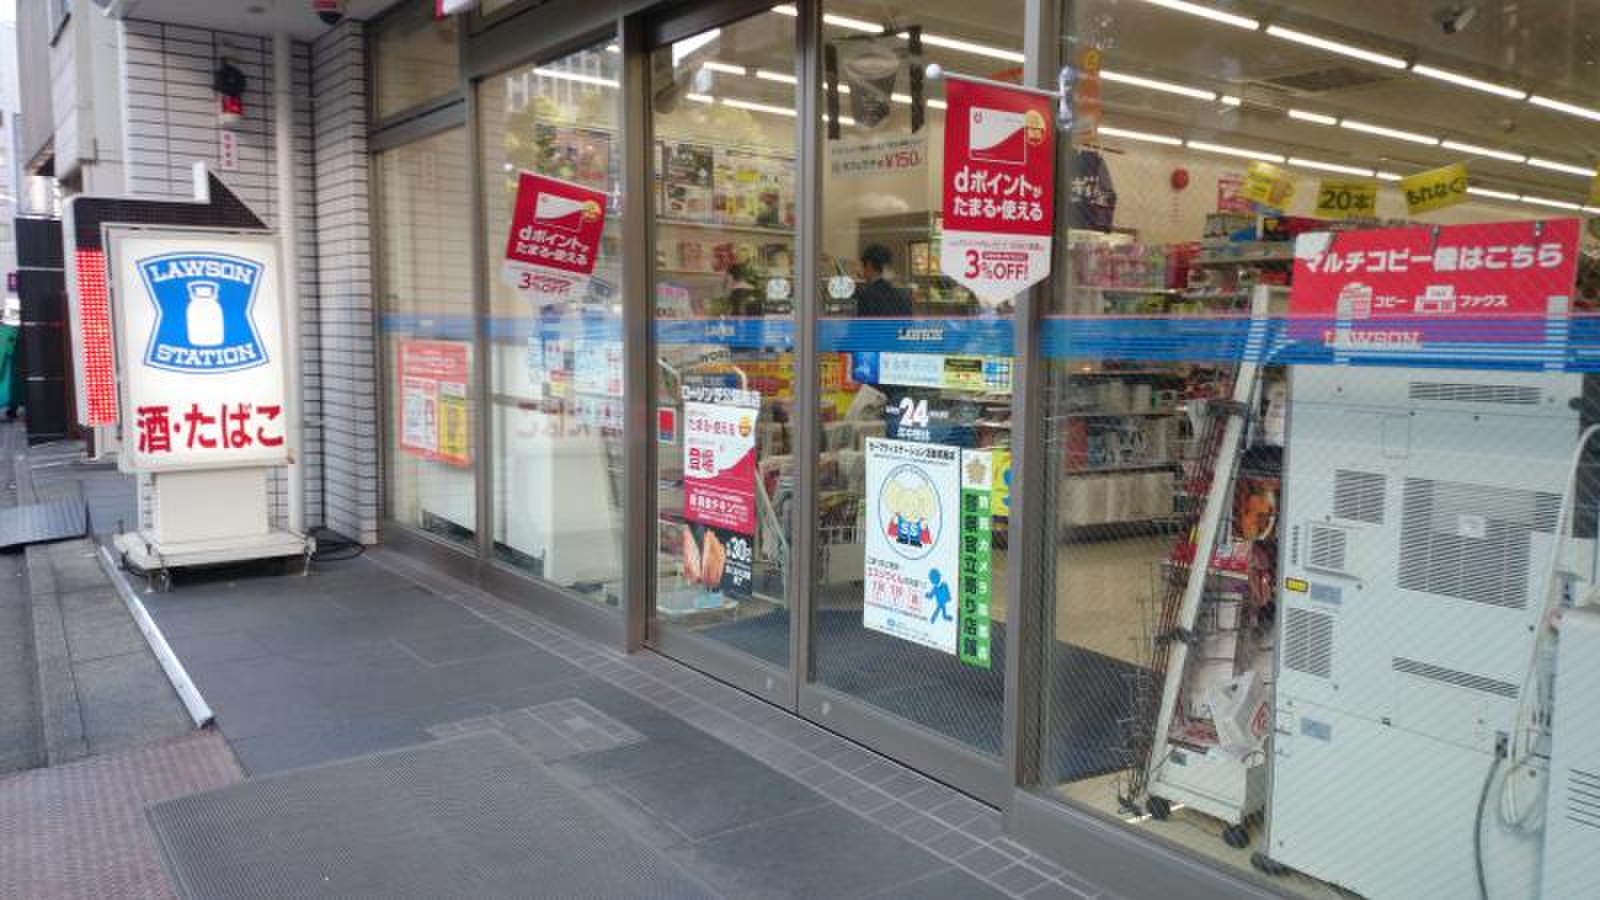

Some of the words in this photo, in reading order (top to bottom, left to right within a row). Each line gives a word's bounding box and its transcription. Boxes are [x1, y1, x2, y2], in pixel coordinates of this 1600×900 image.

[953, 196, 1043, 221] たまる・使える
[150, 259, 254, 284] LAWSON
[1305, 242, 1564, 274] マルチコピー機はこちら
[158, 343, 257, 366] STATION
[899, 397, 928, 427] 24
[137, 403, 284, 453] 酒・たばこ
